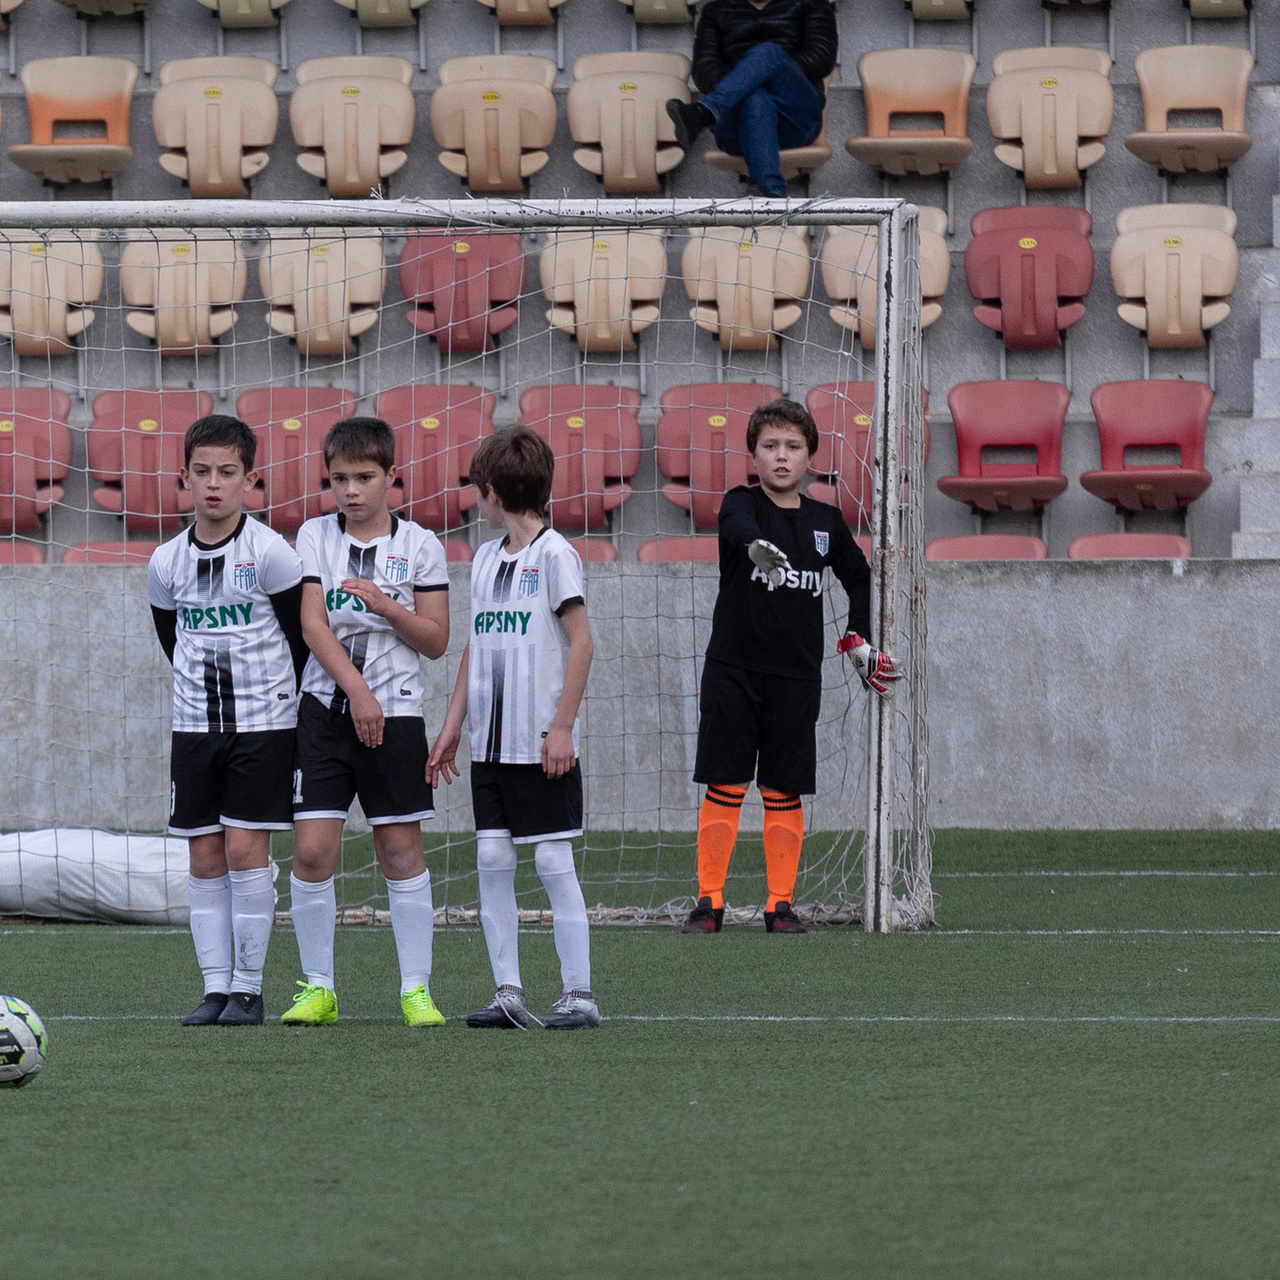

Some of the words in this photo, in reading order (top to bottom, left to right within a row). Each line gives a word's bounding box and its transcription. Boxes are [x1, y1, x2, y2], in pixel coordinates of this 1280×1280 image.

[326, 588, 400, 613] APS
[182, 602, 254, 631] APSNY
[474, 611, 532, 636] APSNY
